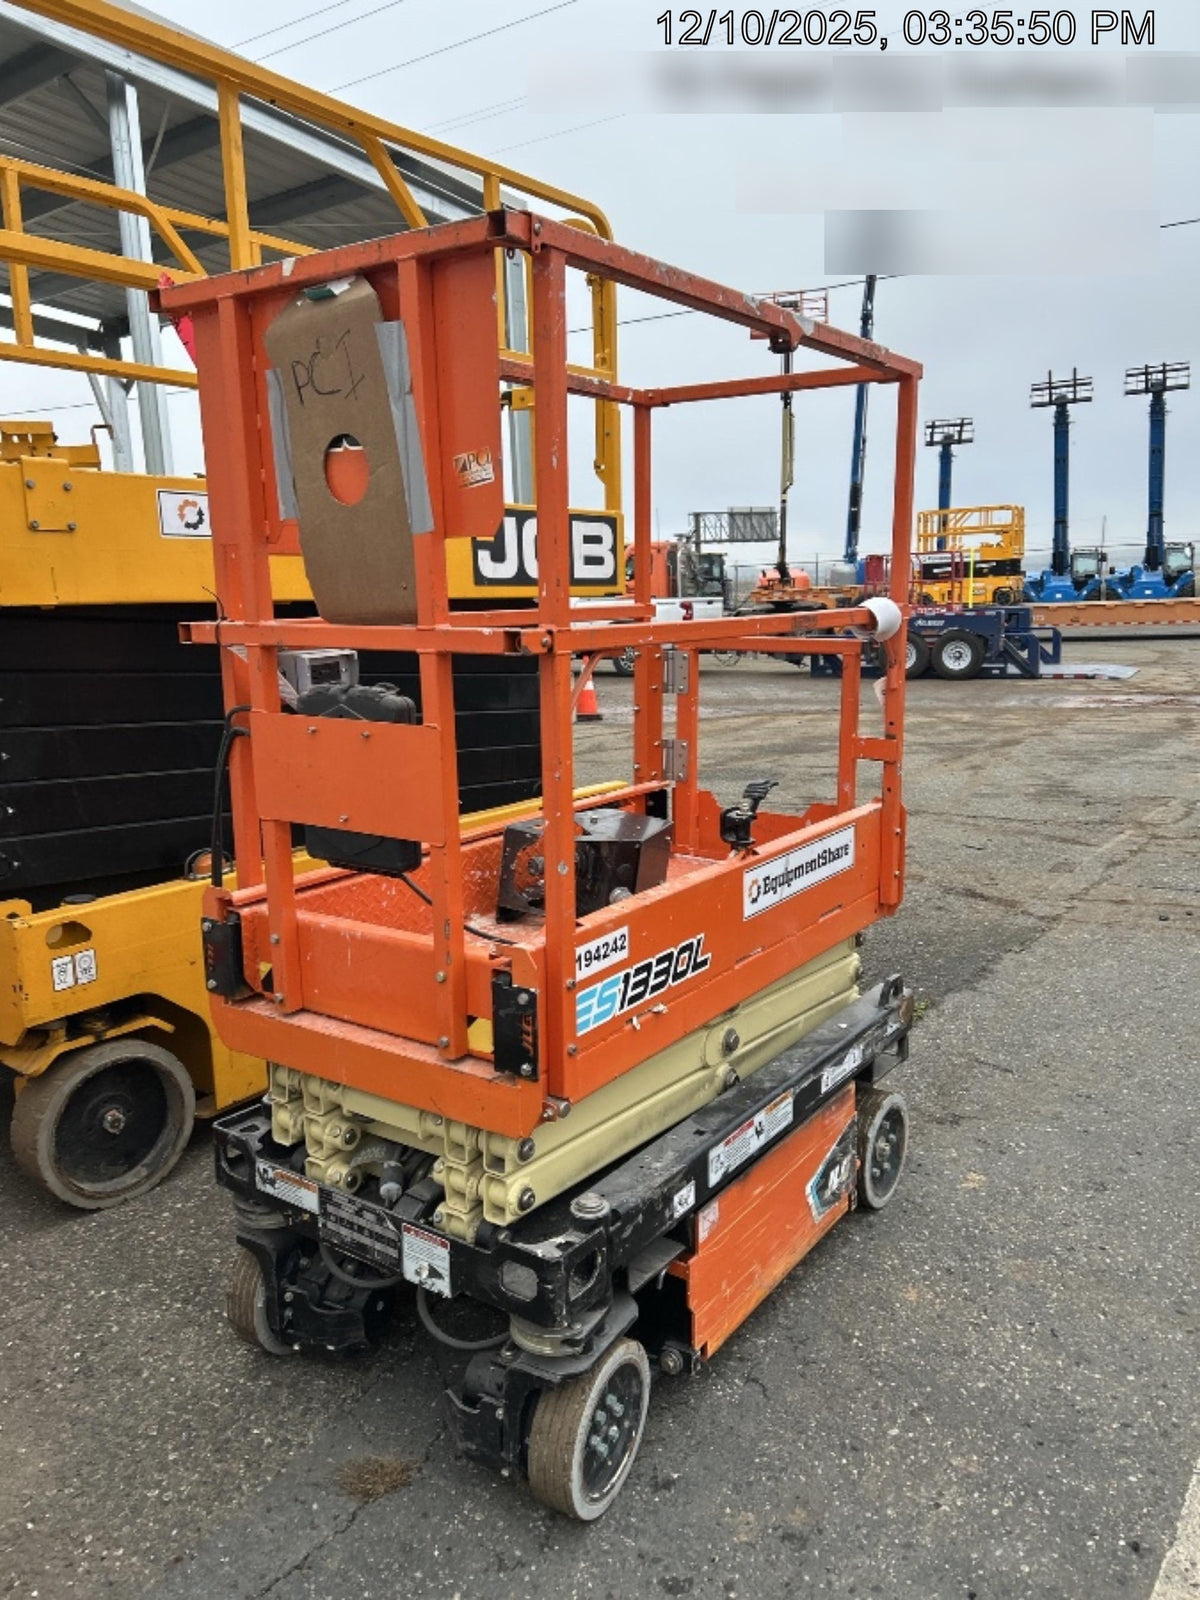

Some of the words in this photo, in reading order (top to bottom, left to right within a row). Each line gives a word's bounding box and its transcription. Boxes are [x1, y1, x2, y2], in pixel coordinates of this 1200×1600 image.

[291, 328, 365, 405] PCI
[762, 843, 849, 895] EquipmentShare
[576, 933, 627, 971] 194242
[576, 934, 711, 1036] ES1330L
